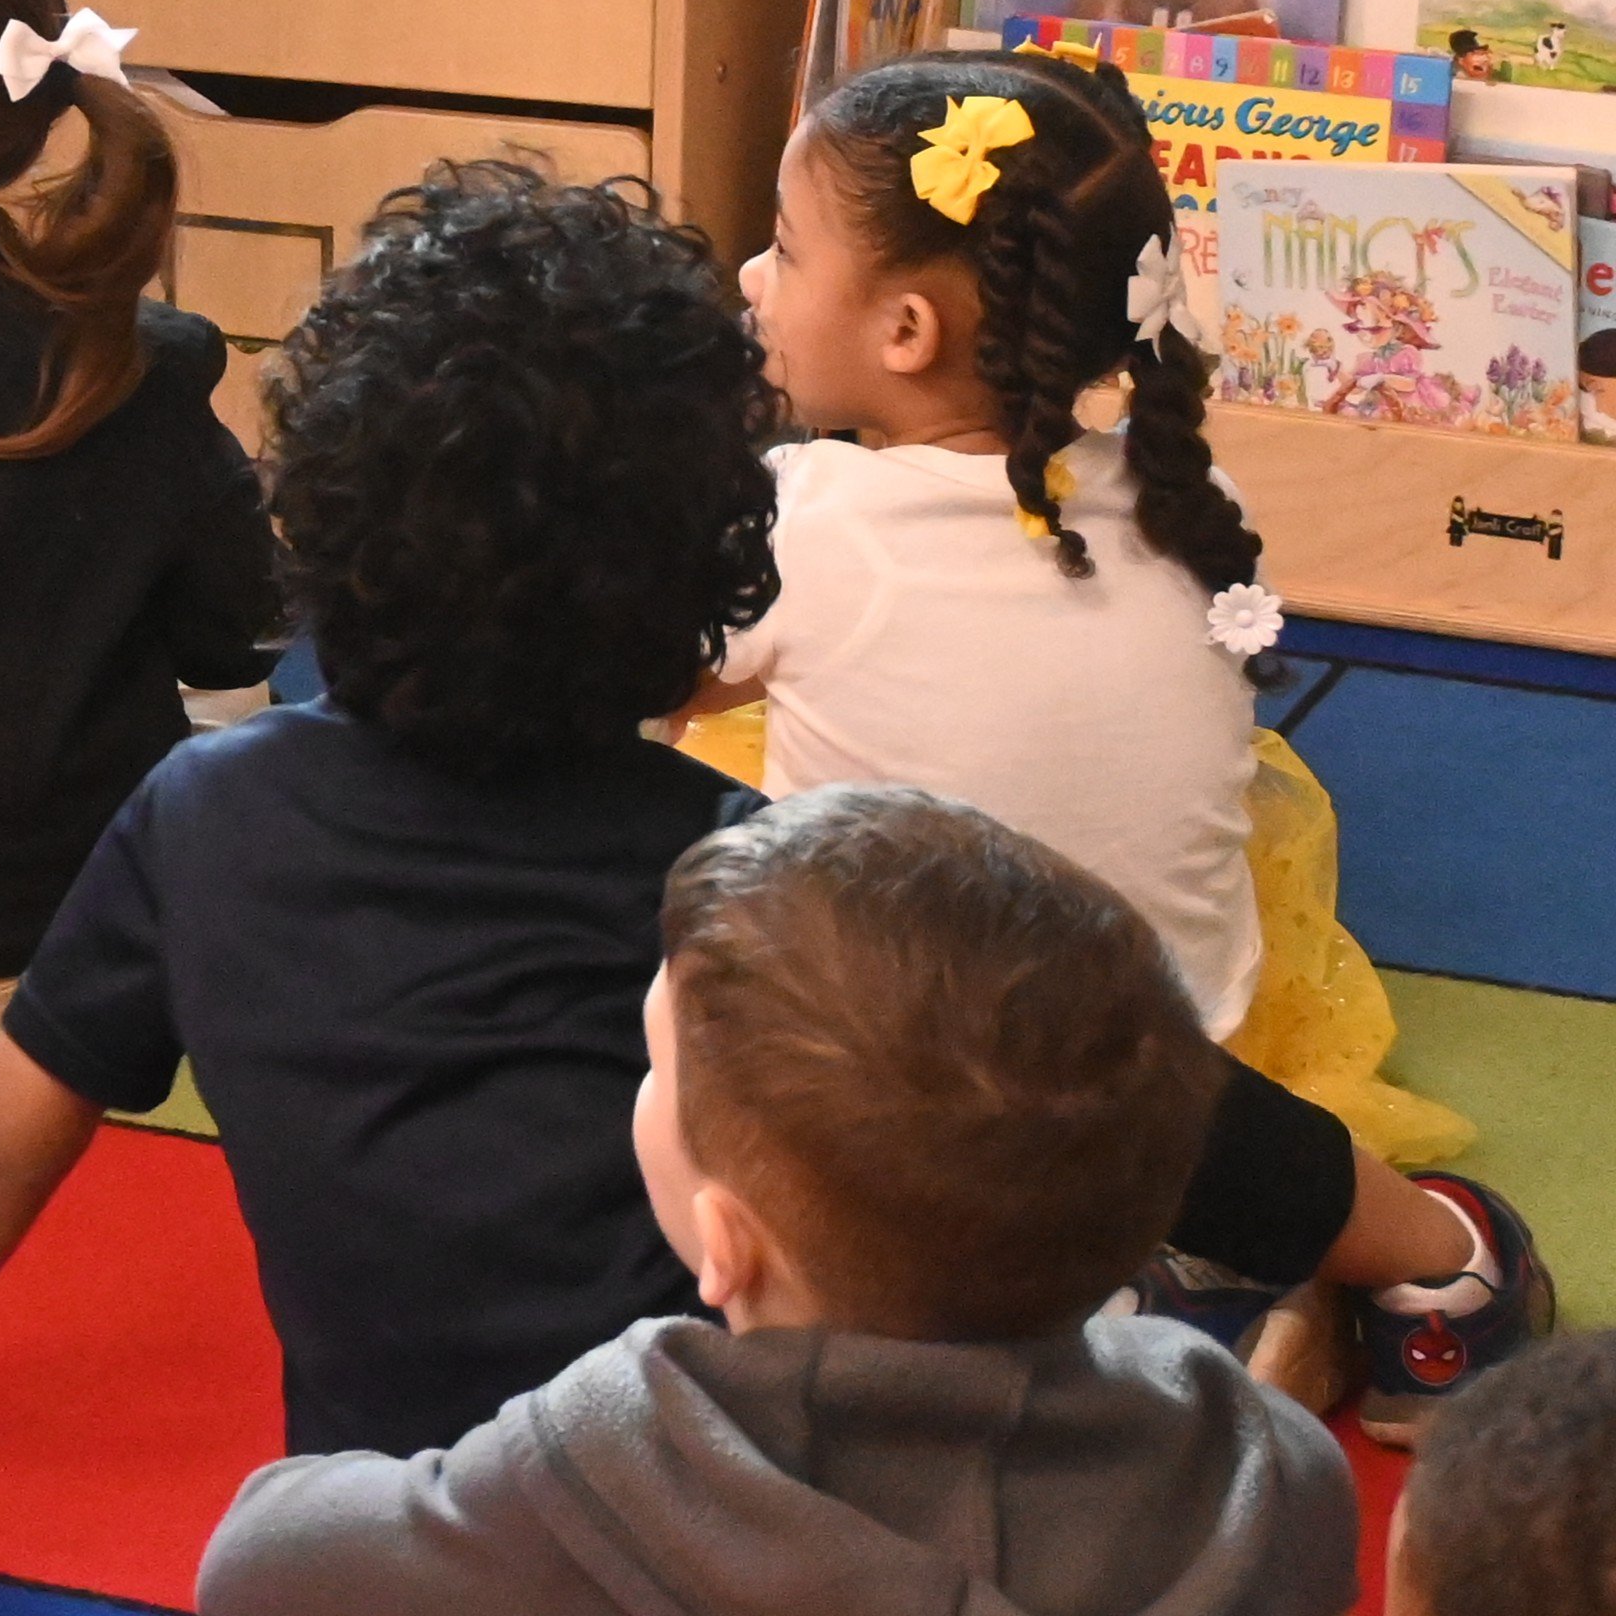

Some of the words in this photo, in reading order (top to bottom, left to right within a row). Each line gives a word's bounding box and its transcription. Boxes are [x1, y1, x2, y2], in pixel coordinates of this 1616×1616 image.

[1114, 45, 1129, 63] 5
[1215, 57, 1229, 77] 9
[1273, 60, 1288, 81] 11
[1299, 64, 1321, 86] 12
[1399, 72, 1422, 95] 15
[1235, 96, 1381, 157] George
